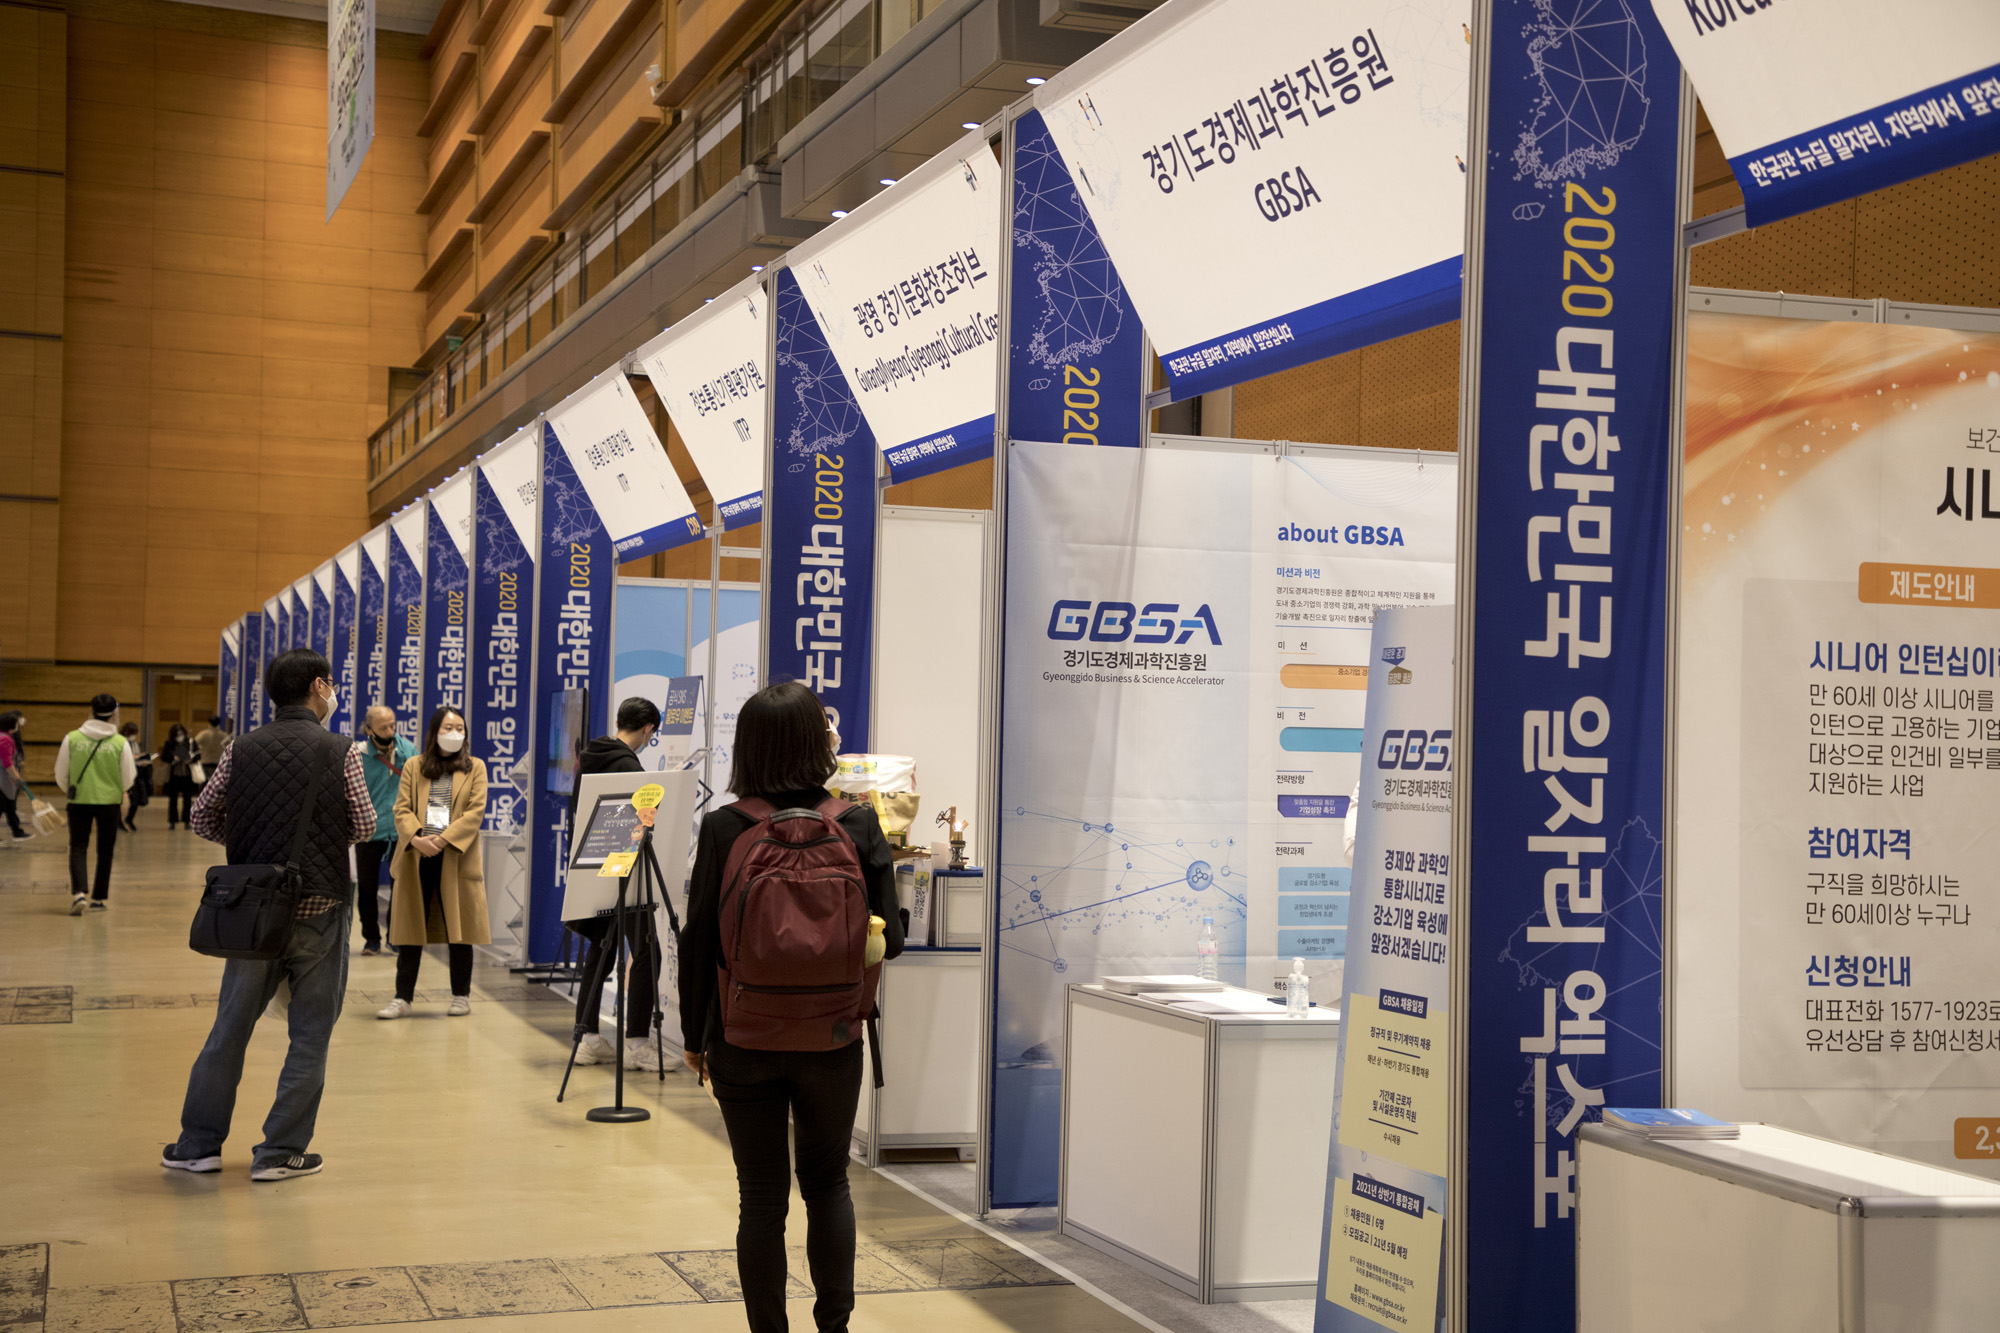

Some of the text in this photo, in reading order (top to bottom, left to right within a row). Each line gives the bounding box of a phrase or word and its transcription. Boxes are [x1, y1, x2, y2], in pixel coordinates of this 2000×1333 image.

[1142, 28, 1394, 194] 경기도경제과학진흥원
[1748, 149, 1801, 188] 한국판
[1794, 138, 1835, 173] 뉴딜
[1828, 120, 1891, 161] 일자리,
[1884, 92, 1966, 139] 지역에서
[1254, 165, 1322, 222] GBSA
[1562, 182, 1617, 318] 2020
[853, 247, 988, 339] 광명 경기문화창조허브
[904, 331, 951, 378] Gyeonggi
[942, 314, 985, 356] Cultural
[1223, 335, 1257, 359] 지역에서
[1063, 365, 1100, 446] 2020
[814, 453, 844, 520] 2020
[1524, 326, 1621, 669] 대한민국
[1277, 522, 1405, 546] about GBSA
[569, 543, 591, 587] 2020
[1276, 567, 1320, 579] 미션과 비전
[499, 572, 518, 610] 2020
[1276, 587, 1343, 597] 경기도경제과학진흥원은
[1889, 571, 1975, 602] 제도안내
[795, 524, 846, 694] 대한민국
[1276, 600, 1288, 608] 도내
[1290, 600, 1321, 609] 중소기업의
[1276, 612, 1301, 621] 기술개발
[1329, 614, 1346, 622] 일자리
[1047, 599, 1222, 645] GBSA
[436, 590, 465, 709] 2020 대한민국
[487, 612, 519, 710] 대한민국
[1063, 650, 1207, 671] 경기도경제과학진흥원
[1810, 640, 2000, 678] 시니어 인턴십이
[1043, 671, 1225, 686] Gyeonggido Business & Science Accelerator
[1338, 668, 1360, 676] 중소기업
[1809, 683, 1994, 712] 만 60세 이상 시니어를
[1809, 713, 2000, 741] 인턴으로 고용하는 기업
[1378, 730, 1452, 771] GBS
[1809, 743, 2000, 770] 대상으로 인건비 일부를
[1276, 774, 1305, 784] 전략방향
[1808, 772, 1924, 797] 지원하는 사업
[1372, 800, 1399, 812] Gyeonggido
[1400, 802, 1421, 812] Business
[1426, 803, 1444, 813] Science
[1522, 696, 1610, 943] 일자리
[1275, 846, 1305, 856] 전략과제
[1808, 827, 1911, 860] 참여자격
[1385, 849, 1449, 876] 경제와 과학의
[1384, 877, 1446, 905] 통합시너지로
[1806, 872, 1960, 897] 구직을 희망하시는
[1373, 904, 1449, 936] 강소기업 육성에
[1806, 901, 1971, 926] 만 60세이상 누구나
[1371, 932, 1447, 965] 앞장서겠습니다!
[1806, 955, 1911, 988] 신청안내
[1382, 994, 1424, 1015] GBSA 채용일정
[1806, 999, 1884, 1024] 대표전화
[1370, 1026, 1431, 1051] 정규직 및 무기계약직 채용
[1806, 1029, 1884, 1053] 유선상담
[1889, 1029, 1906, 1052] 후
[1379, 1102, 1405, 1119] 시설운영직
[1406, 1111, 1417, 1124] 직원
[1395, 1093, 1412, 1109] 근로자
[1383, 1132, 1401, 1146] 수시채용
[1356, 1180, 1420, 1214] 2021년 상반기 통합공채
[1350, 1208, 1385, 1231] 채용인원 6명
[1348, 1226, 1408, 1260] 모집공고 21년 5월 예정
